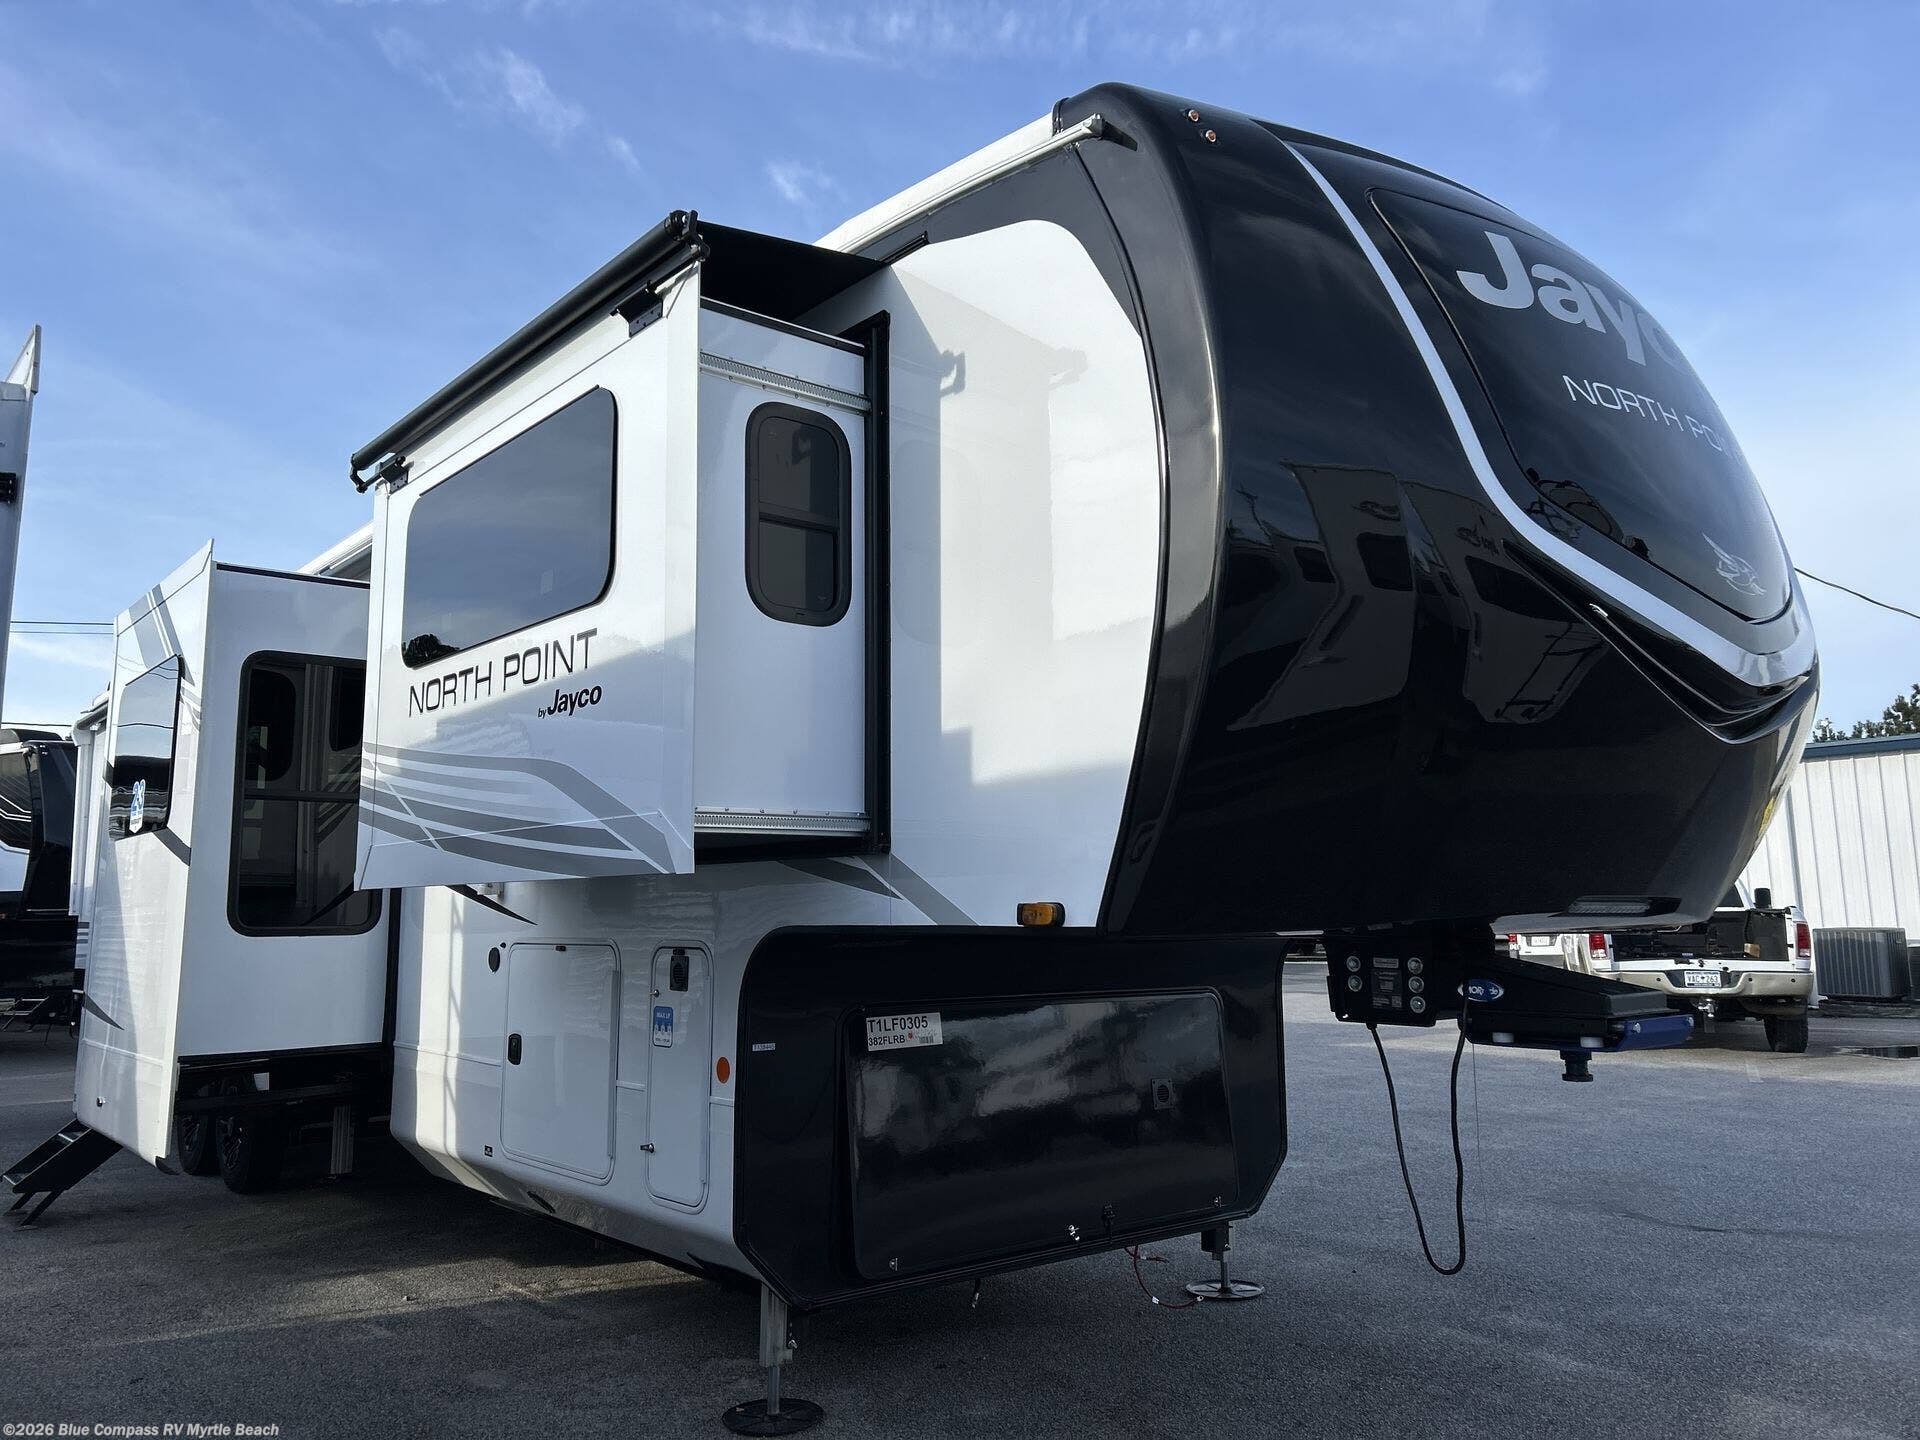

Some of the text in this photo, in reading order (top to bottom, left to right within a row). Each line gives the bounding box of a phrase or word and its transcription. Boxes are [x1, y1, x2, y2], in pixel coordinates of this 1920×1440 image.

[1562, 375, 1684, 431] NORTH
[408, 628, 598, 718] NORTH POINT
[537, 685, 602, 719] by Jayco
[867, 1015, 929, 1033] T1LF0305
[868, 1034, 906, 1046] 382FLRB
